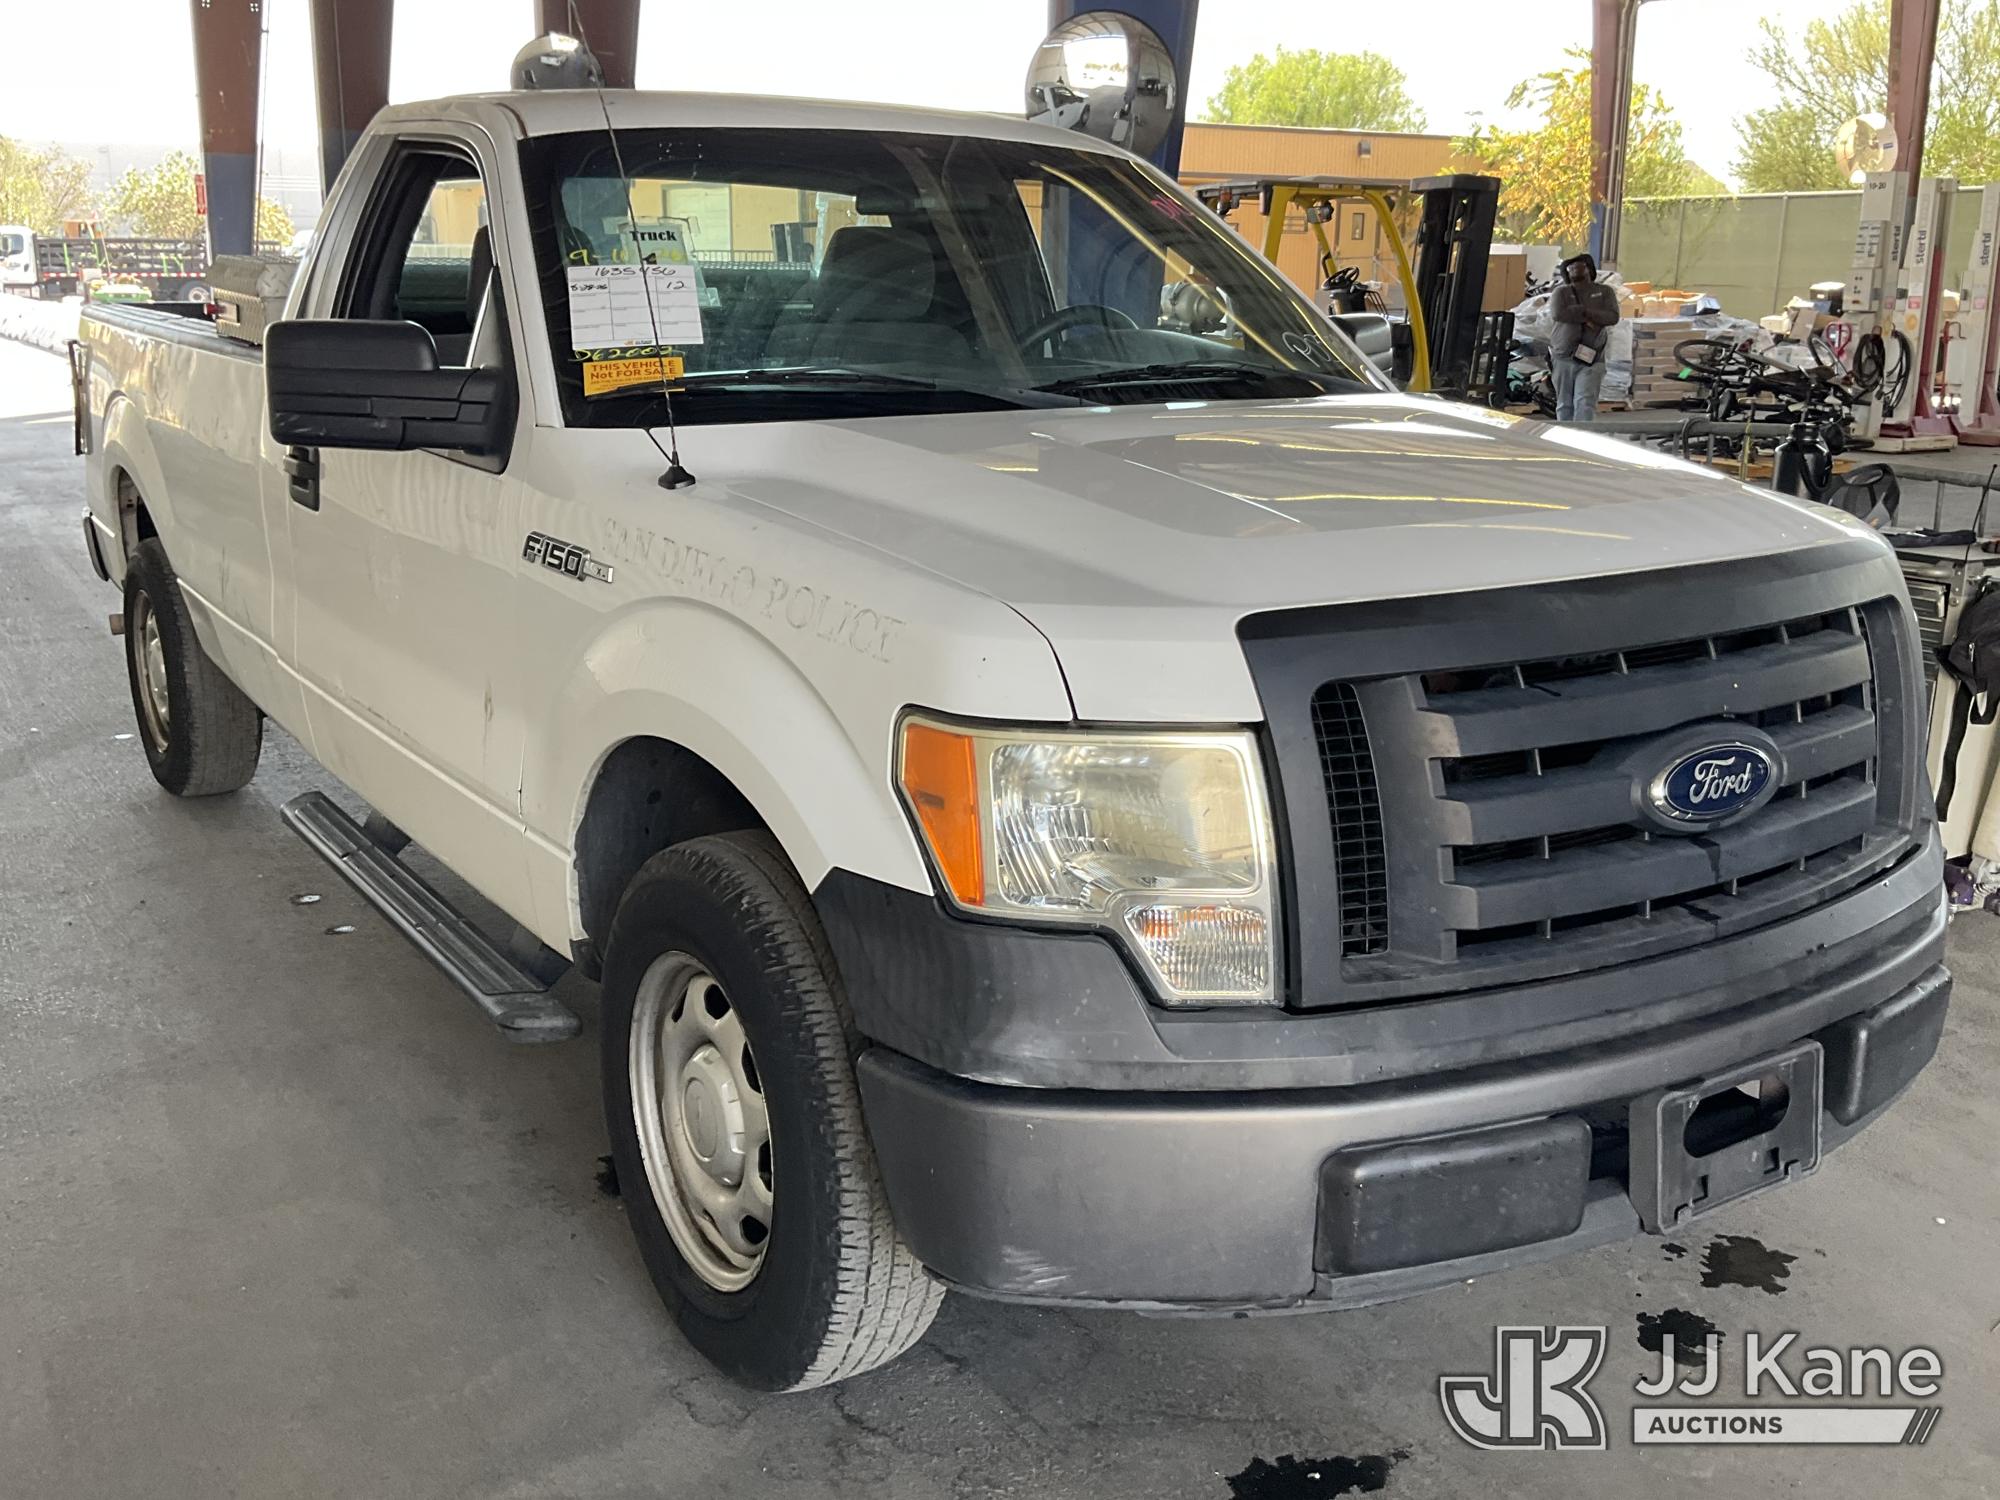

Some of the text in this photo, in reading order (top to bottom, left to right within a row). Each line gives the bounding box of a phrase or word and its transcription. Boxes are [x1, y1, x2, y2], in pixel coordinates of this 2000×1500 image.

[630, 230, 678, 242] Truck
[666, 281, 685, 290] 12
[592, 360, 676, 372] THIS VEHICLE
[590, 370, 613, 380] Not
[616, 369, 642, 377] FOR
[644, 367, 677, 376] SALE
[522, 532, 586, 580] F-150
[1689, 756, 1751, 803] Ford
